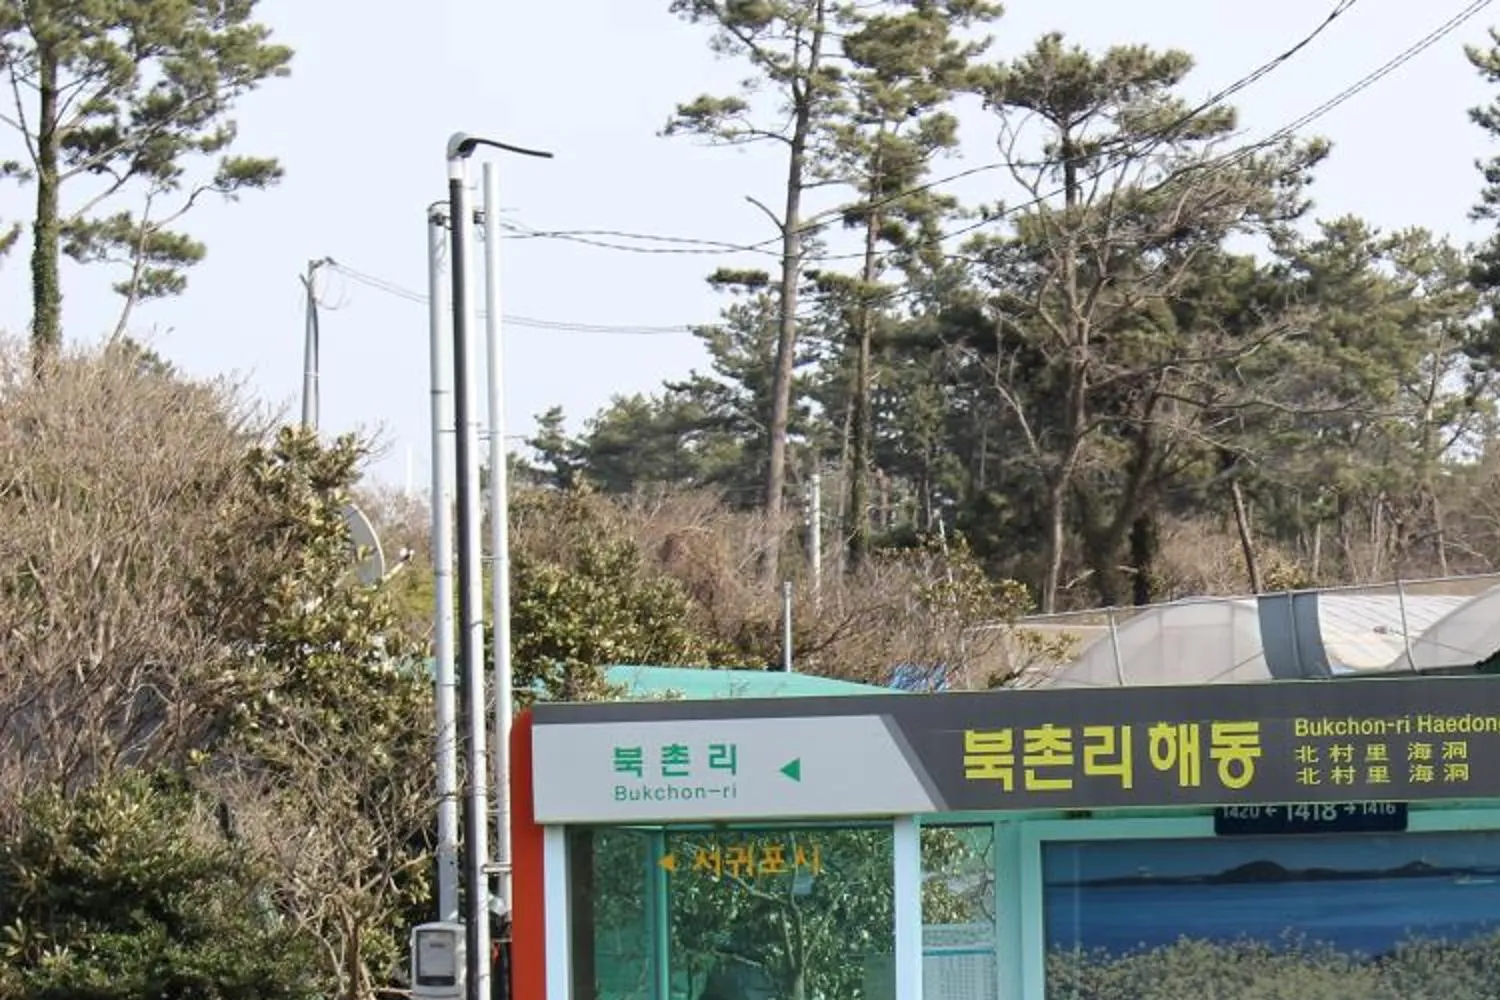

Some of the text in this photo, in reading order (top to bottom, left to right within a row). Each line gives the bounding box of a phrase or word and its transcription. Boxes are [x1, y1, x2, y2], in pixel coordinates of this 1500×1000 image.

[1294, 714, 1410, 736] Bukchon-ri
[613, 783, 738, 801] Bukchon-ri
[1287, 803, 1337, 822] 1418
